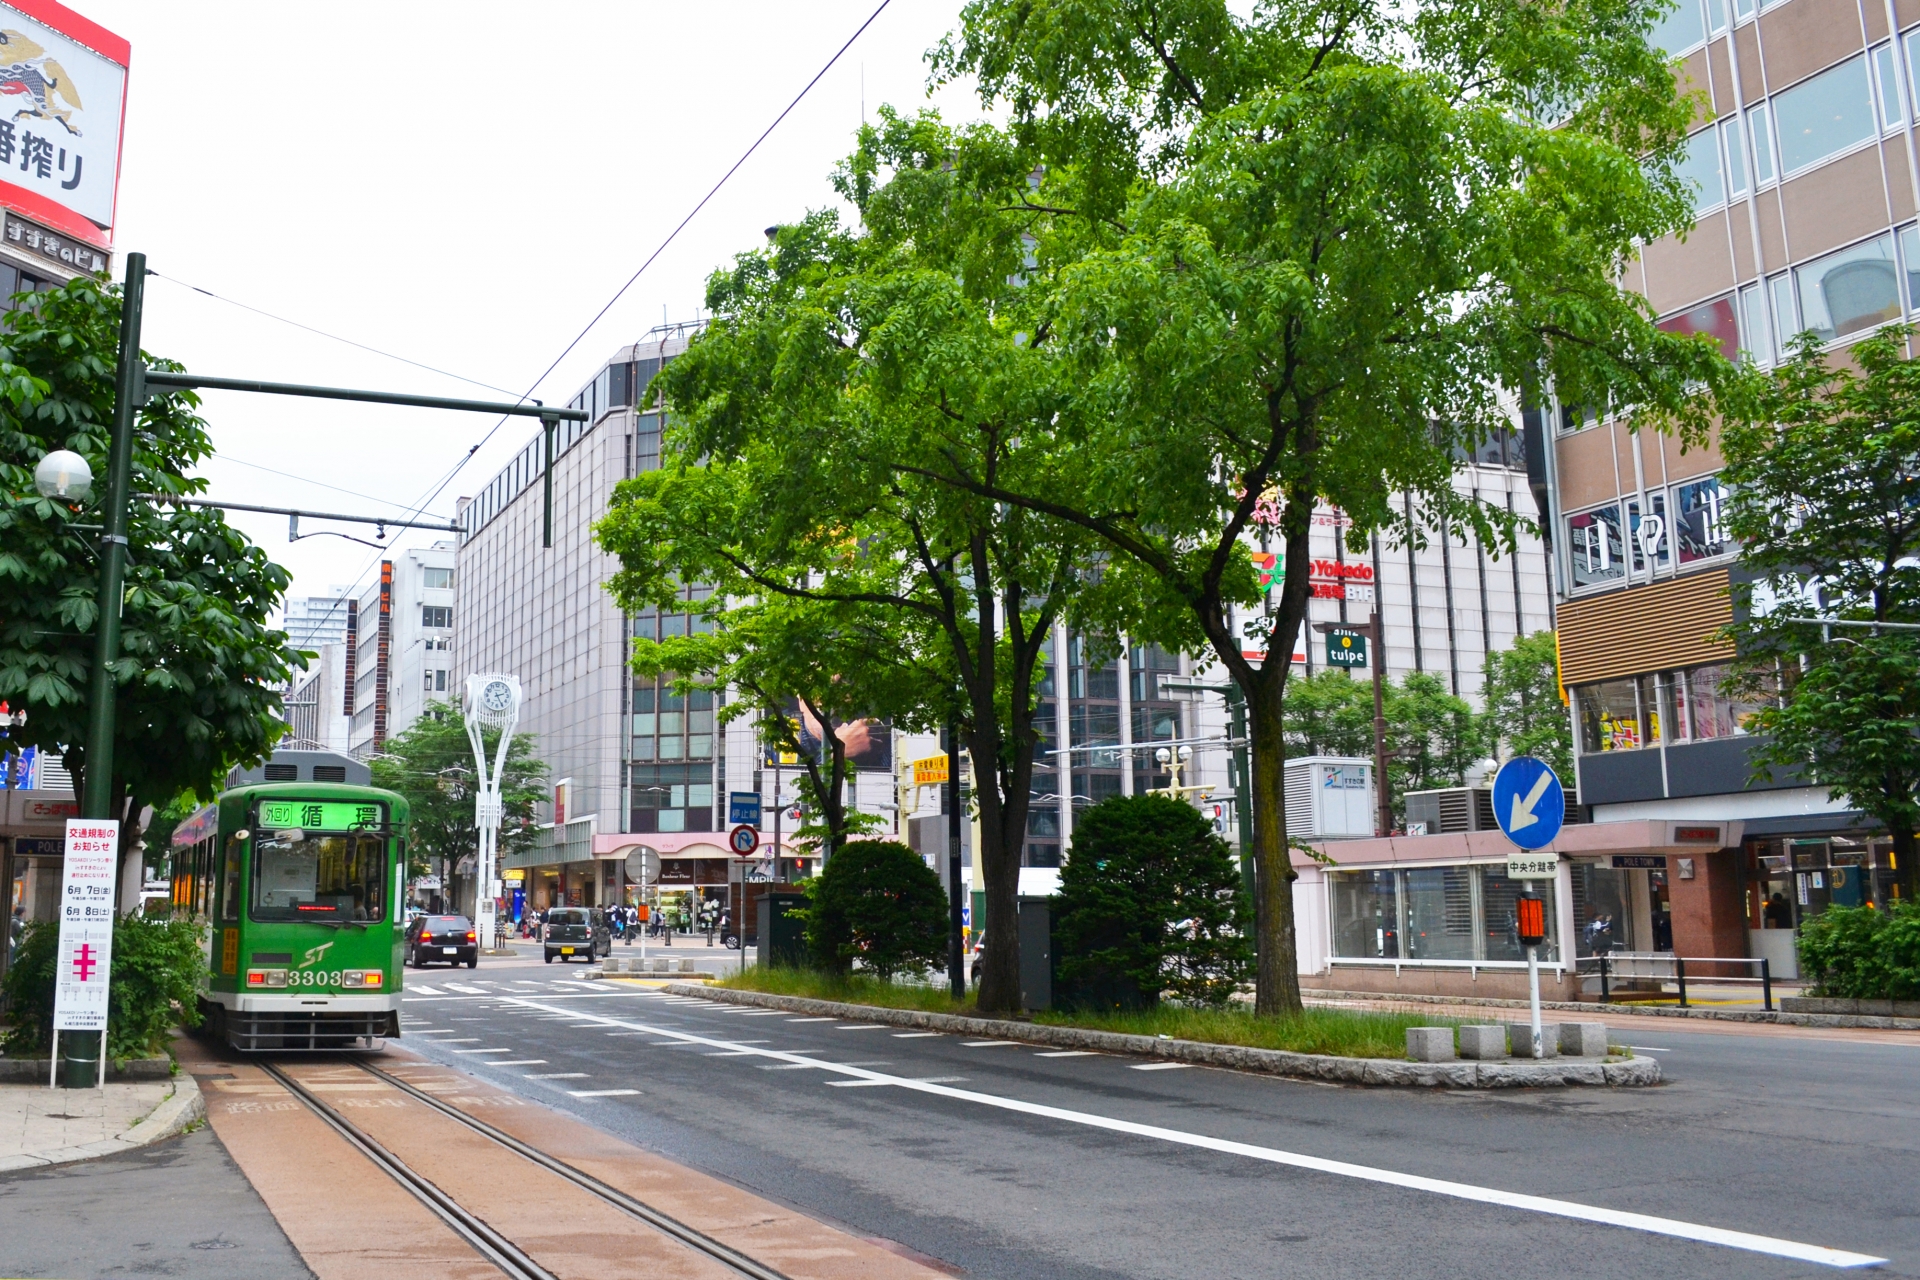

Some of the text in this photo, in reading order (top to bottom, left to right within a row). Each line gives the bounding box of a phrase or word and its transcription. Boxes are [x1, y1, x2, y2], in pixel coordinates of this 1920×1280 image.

[7, 220, 105, 273] すすきのビル
[1346, 586, 1372, 600] B1F
[1331, 649, 1364, 663] tulpe
[265, 807, 290, 823] 外回り
[731, 809, 758, 819] 停止線
[69, 828, 115, 839] 交通規制の
[38, 841, 63, 853] POLE
[73, 841, 110, 851] お知らせ
[67, 885, 81, 895] 6月
[66, 906, 80, 916] 6月
[288, 970, 342, 986] 3303
